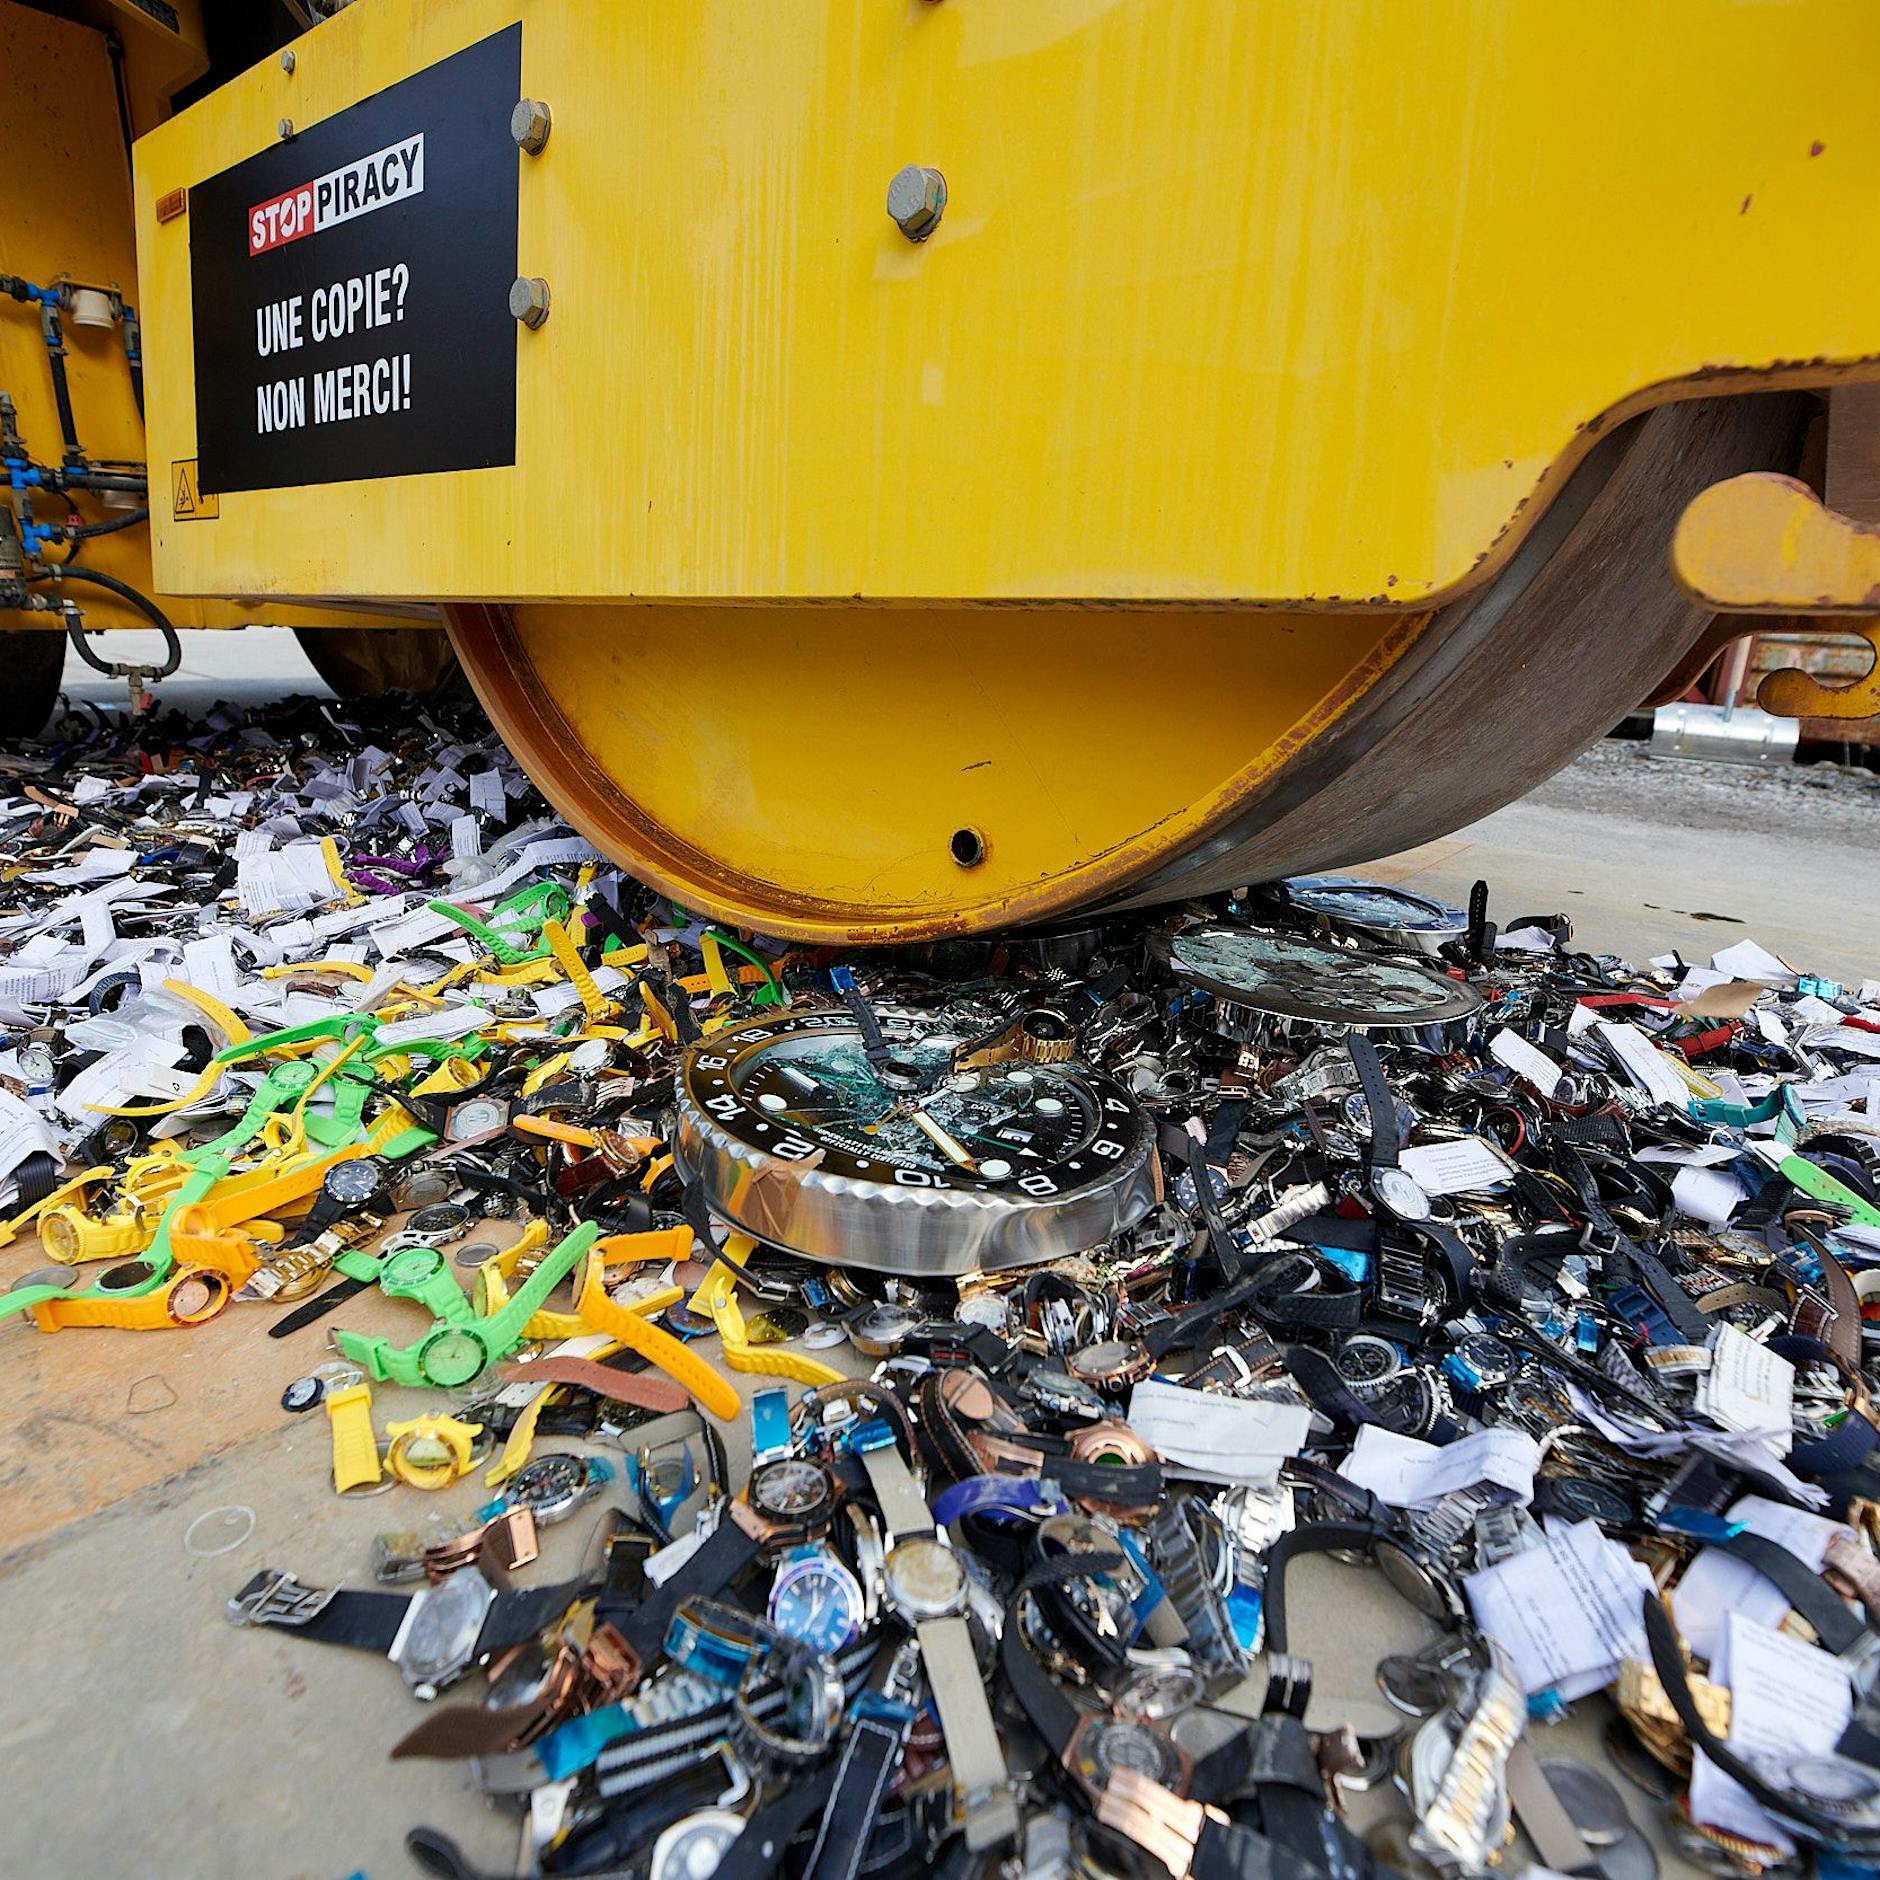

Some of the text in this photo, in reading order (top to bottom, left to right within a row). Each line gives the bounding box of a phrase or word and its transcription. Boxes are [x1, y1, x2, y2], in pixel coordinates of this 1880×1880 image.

[257, 263, 410, 357] UNE COPIE?
[257, 353, 411, 434] NON MERCI!
[731, 1028, 774, 1043] 18
[696, 1054, 728, 1071] 16
[705, 1094, 747, 1121] 14
[1104, 1097, 1131, 1114] 4
[819, 1135, 871, 1157] OFFICIALLY
[869, 1152, 917, 1170] CERTIFIED
[1091, 1139, 1126, 1159] 6
[894, 1168, 952, 1189] 10
[1017, 1174, 1059, 1197] 8
